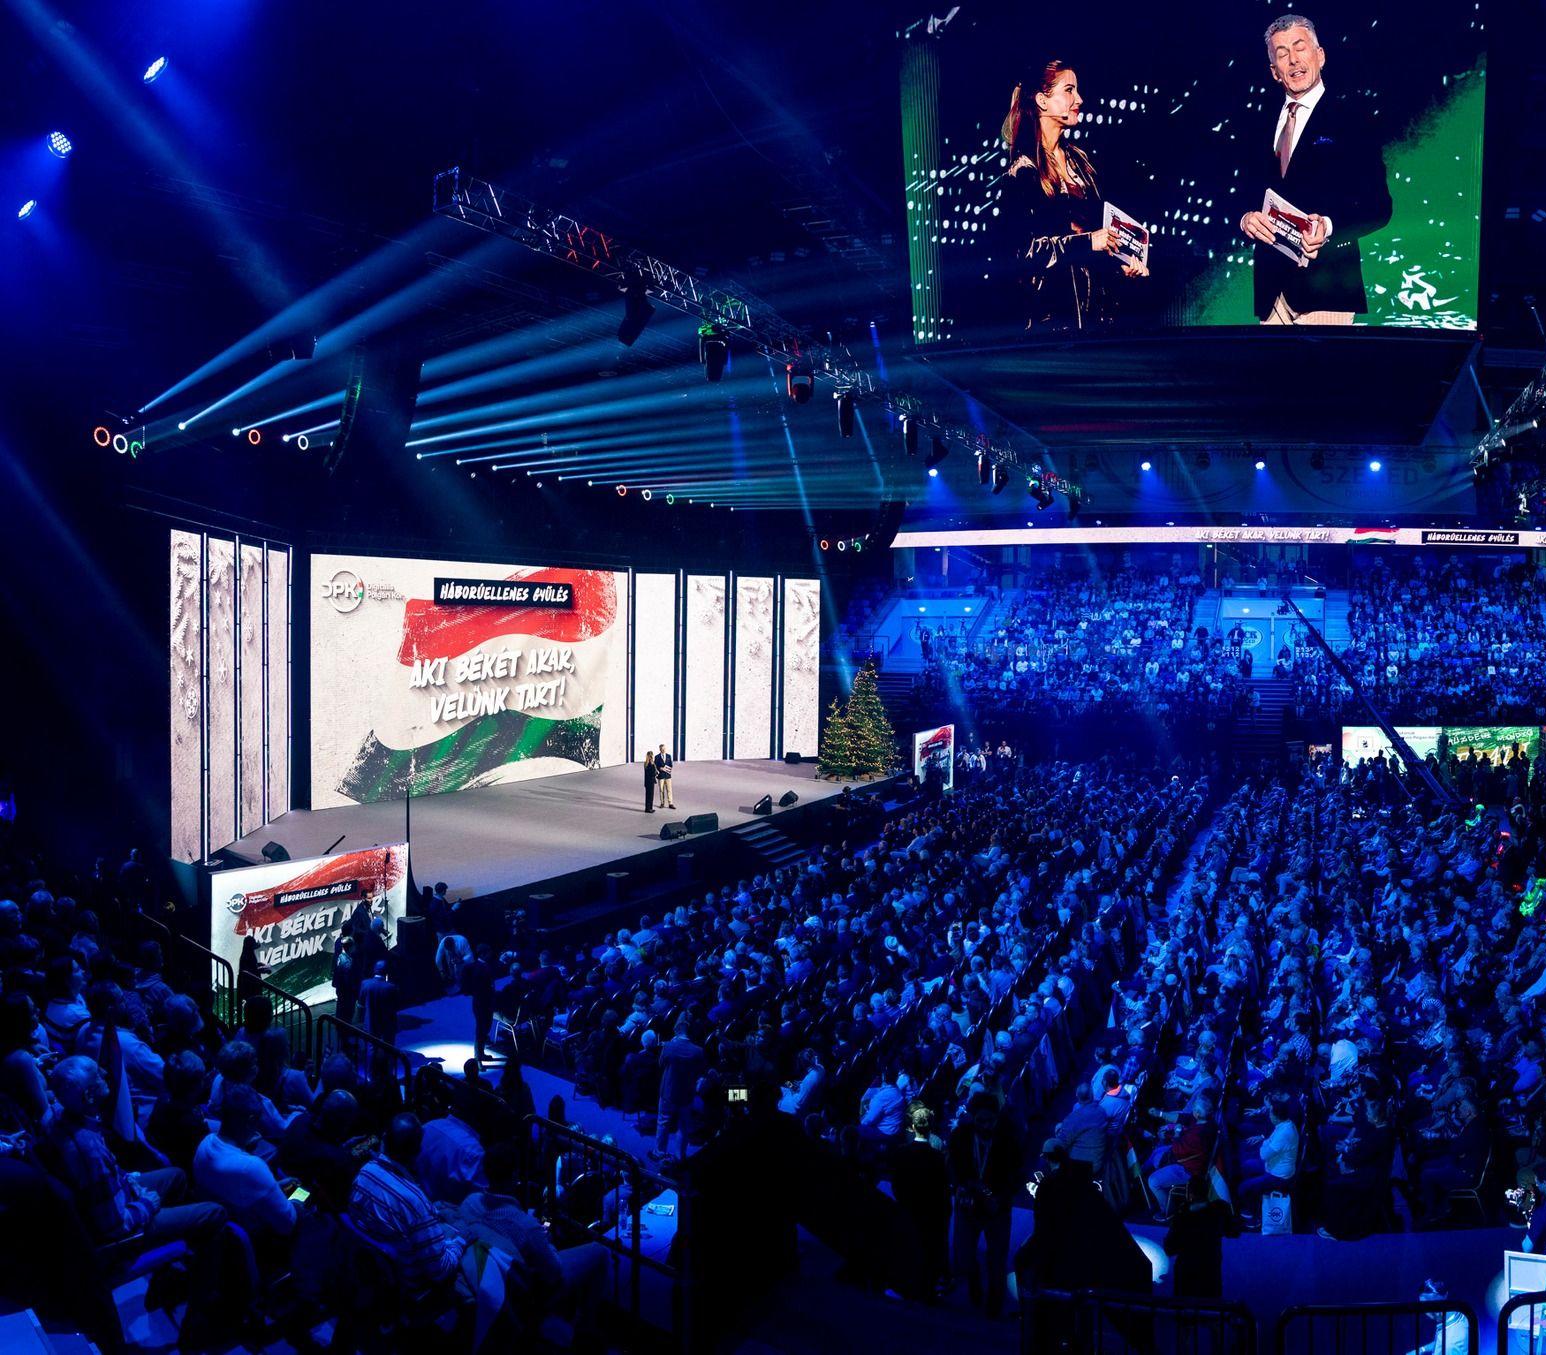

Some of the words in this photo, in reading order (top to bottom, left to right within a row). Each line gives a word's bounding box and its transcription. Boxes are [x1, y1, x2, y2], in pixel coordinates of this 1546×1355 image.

[1321, 466, 1419, 485] SZEED
[1305, 530, 1331, 541] TART!
[440, 582, 529, 601] HÁBORÚELLENES
[533, 584, 569, 602] GYŰLÉS
[409, 656, 448, 688] AKI
[455, 647, 522, 683] BÉKÉT
[526, 646, 575, 675] AKAR,
[430, 685, 509, 722] VELÜNK
[516, 675, 566, 711] TART!
[280, 907, 338, 939] BÉKÉT
[259, 934, 327, 967] VELÜNK
